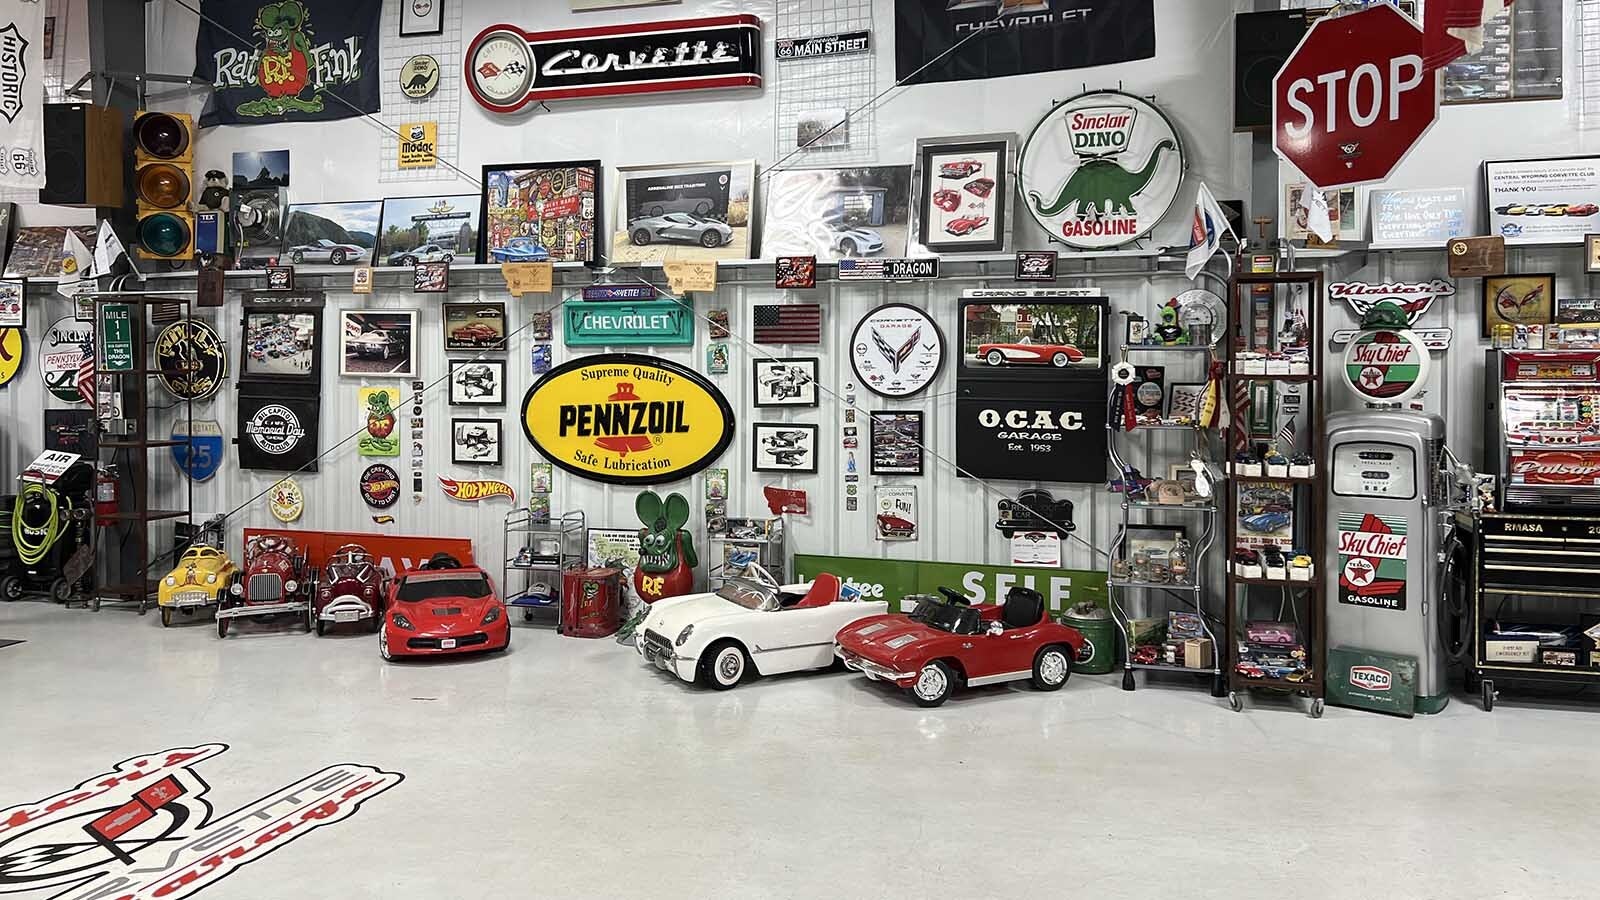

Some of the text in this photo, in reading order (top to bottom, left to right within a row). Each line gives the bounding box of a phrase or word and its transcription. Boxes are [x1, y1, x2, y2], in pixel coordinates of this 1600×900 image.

[955, 8, 1092, 32] CHEVROLET
[780, 37, 867, 56] 66 MAIN STREET
[212, 35, 363, 90] Rat Fink
[541, 40, 740, 76] Corvette
[2, 35, 19, 111] HISTORIC
[1284, 54, 1424, 139] STOP
[1071, 113, 1130, 130] Sinclair
[402, 142, 433, 153] Modac
[1074, 131, 1126, 148] DINO
[12, 153, 26, 171] 66
[1062, 218, 1137, 237] GASOLINE
[893, 262, 933, 275] DRAGON
[105, 311, 128, 319] MILE
[583, 314, 671, 330] CHEVROLET
[114, 320, 120, 330] 1
[115, 330, 120, 341] 1
[1353, 345, 1411, 365] Sky Chief
[581, 366, 675, 387] Supreme Quality
[559, 400, 690, 438] PENNZOIL
[978, 409, 1086, 431] O.C.A.C.
[178, 424, 216, 433] INTRSTATE
[246, 421, 306, 438] Memorial Day
[997, 431, 1062, 441] GARAGE
[1030, 443, 1052, 452] 1953
[44, 453, 72, 463] AIR
[184, 445, 212, 469] 25
[573, 450, 672, 471] Safe Lubrication
[455, 482, 477, 499] HOT
[895, 498, 912, 515] FUN!
[1503, 522, 1544, 533] RMASA
[1338, 532, 1408, 557] Sky Chief
[1349, 559, 1371, 568] TEXACO
[1347, 595, 1398, 607] GASOLINE
[1353, 671, 1388, 684] TEXACO
